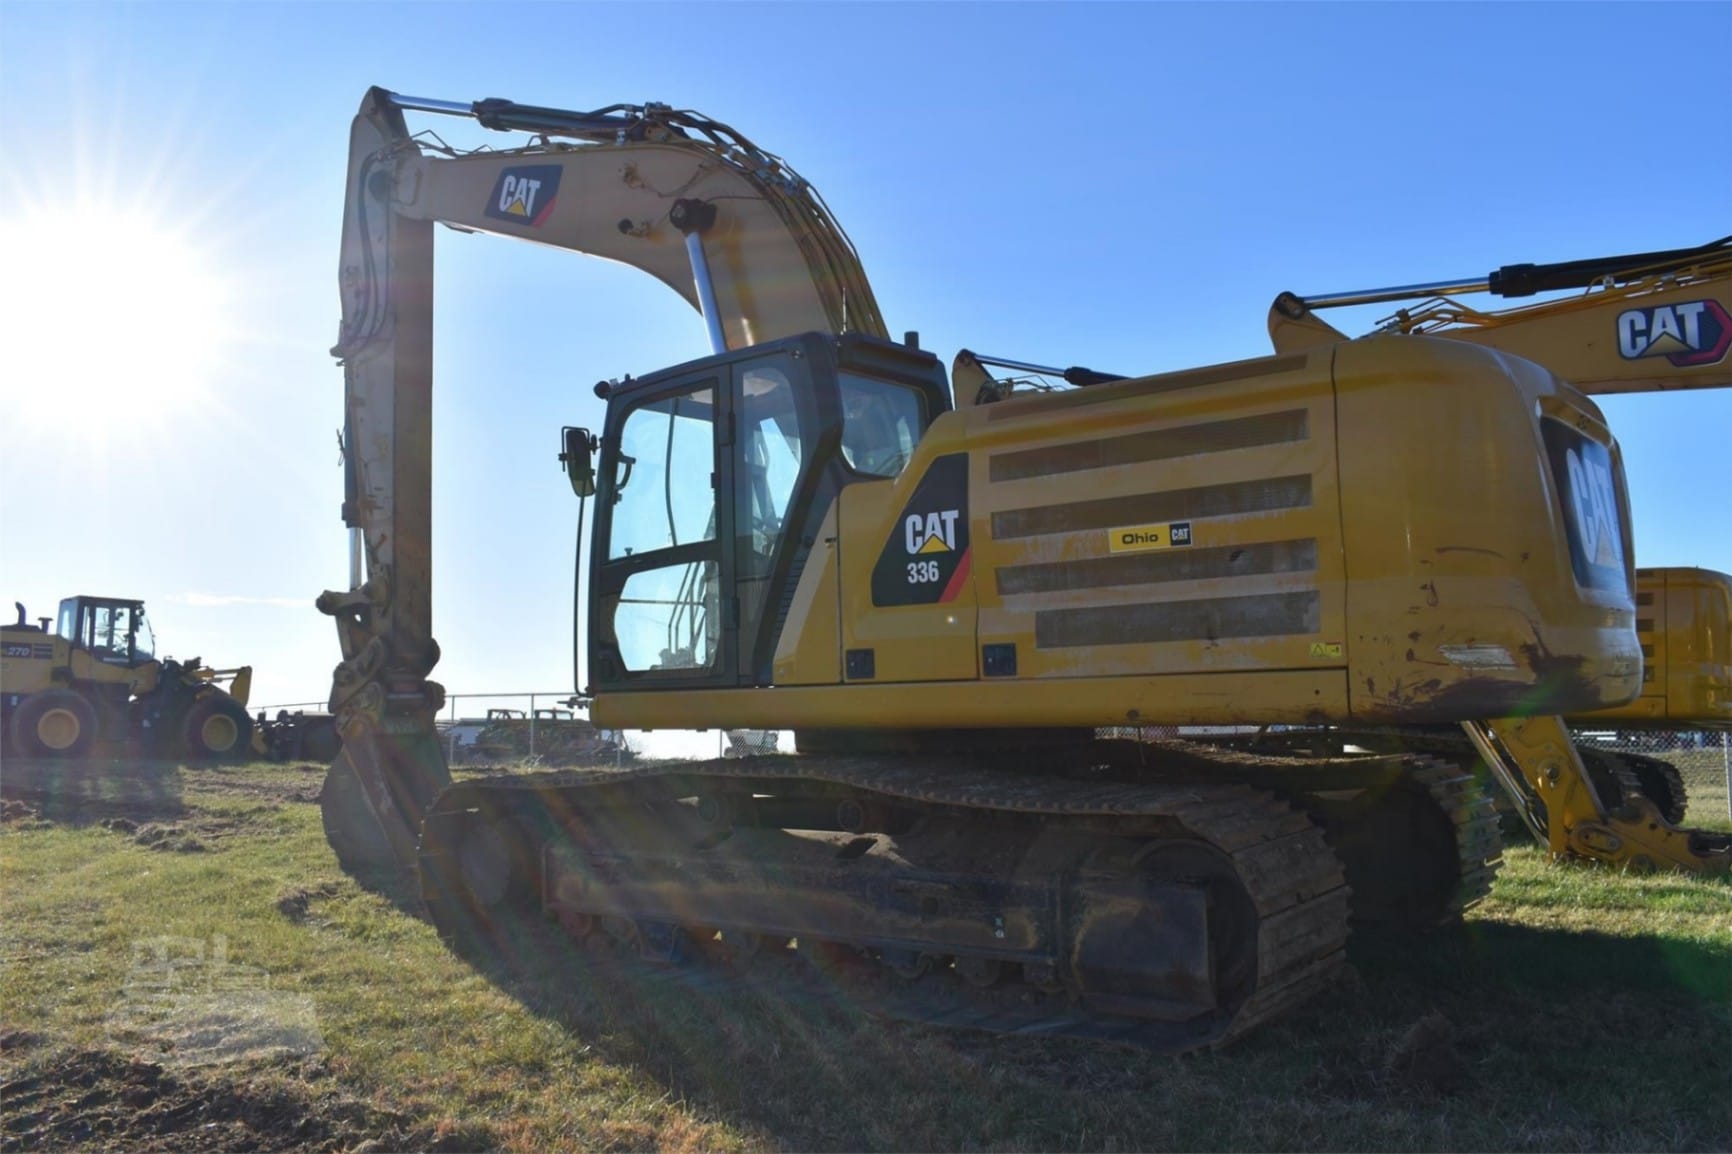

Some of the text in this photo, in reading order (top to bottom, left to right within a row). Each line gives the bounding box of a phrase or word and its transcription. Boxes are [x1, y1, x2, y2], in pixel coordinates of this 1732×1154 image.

[499, 175, 541, 217] CAT
[1618, 302, 1704, 358] CAT
[1566, 448, 1622, 570] CAT
[905, 510, 959, 555] CAT
[1122, 528, 1189, 545] Ohio CAT
[907, 561, 939, 584] 336
[8, 647, 30, 656] 270
